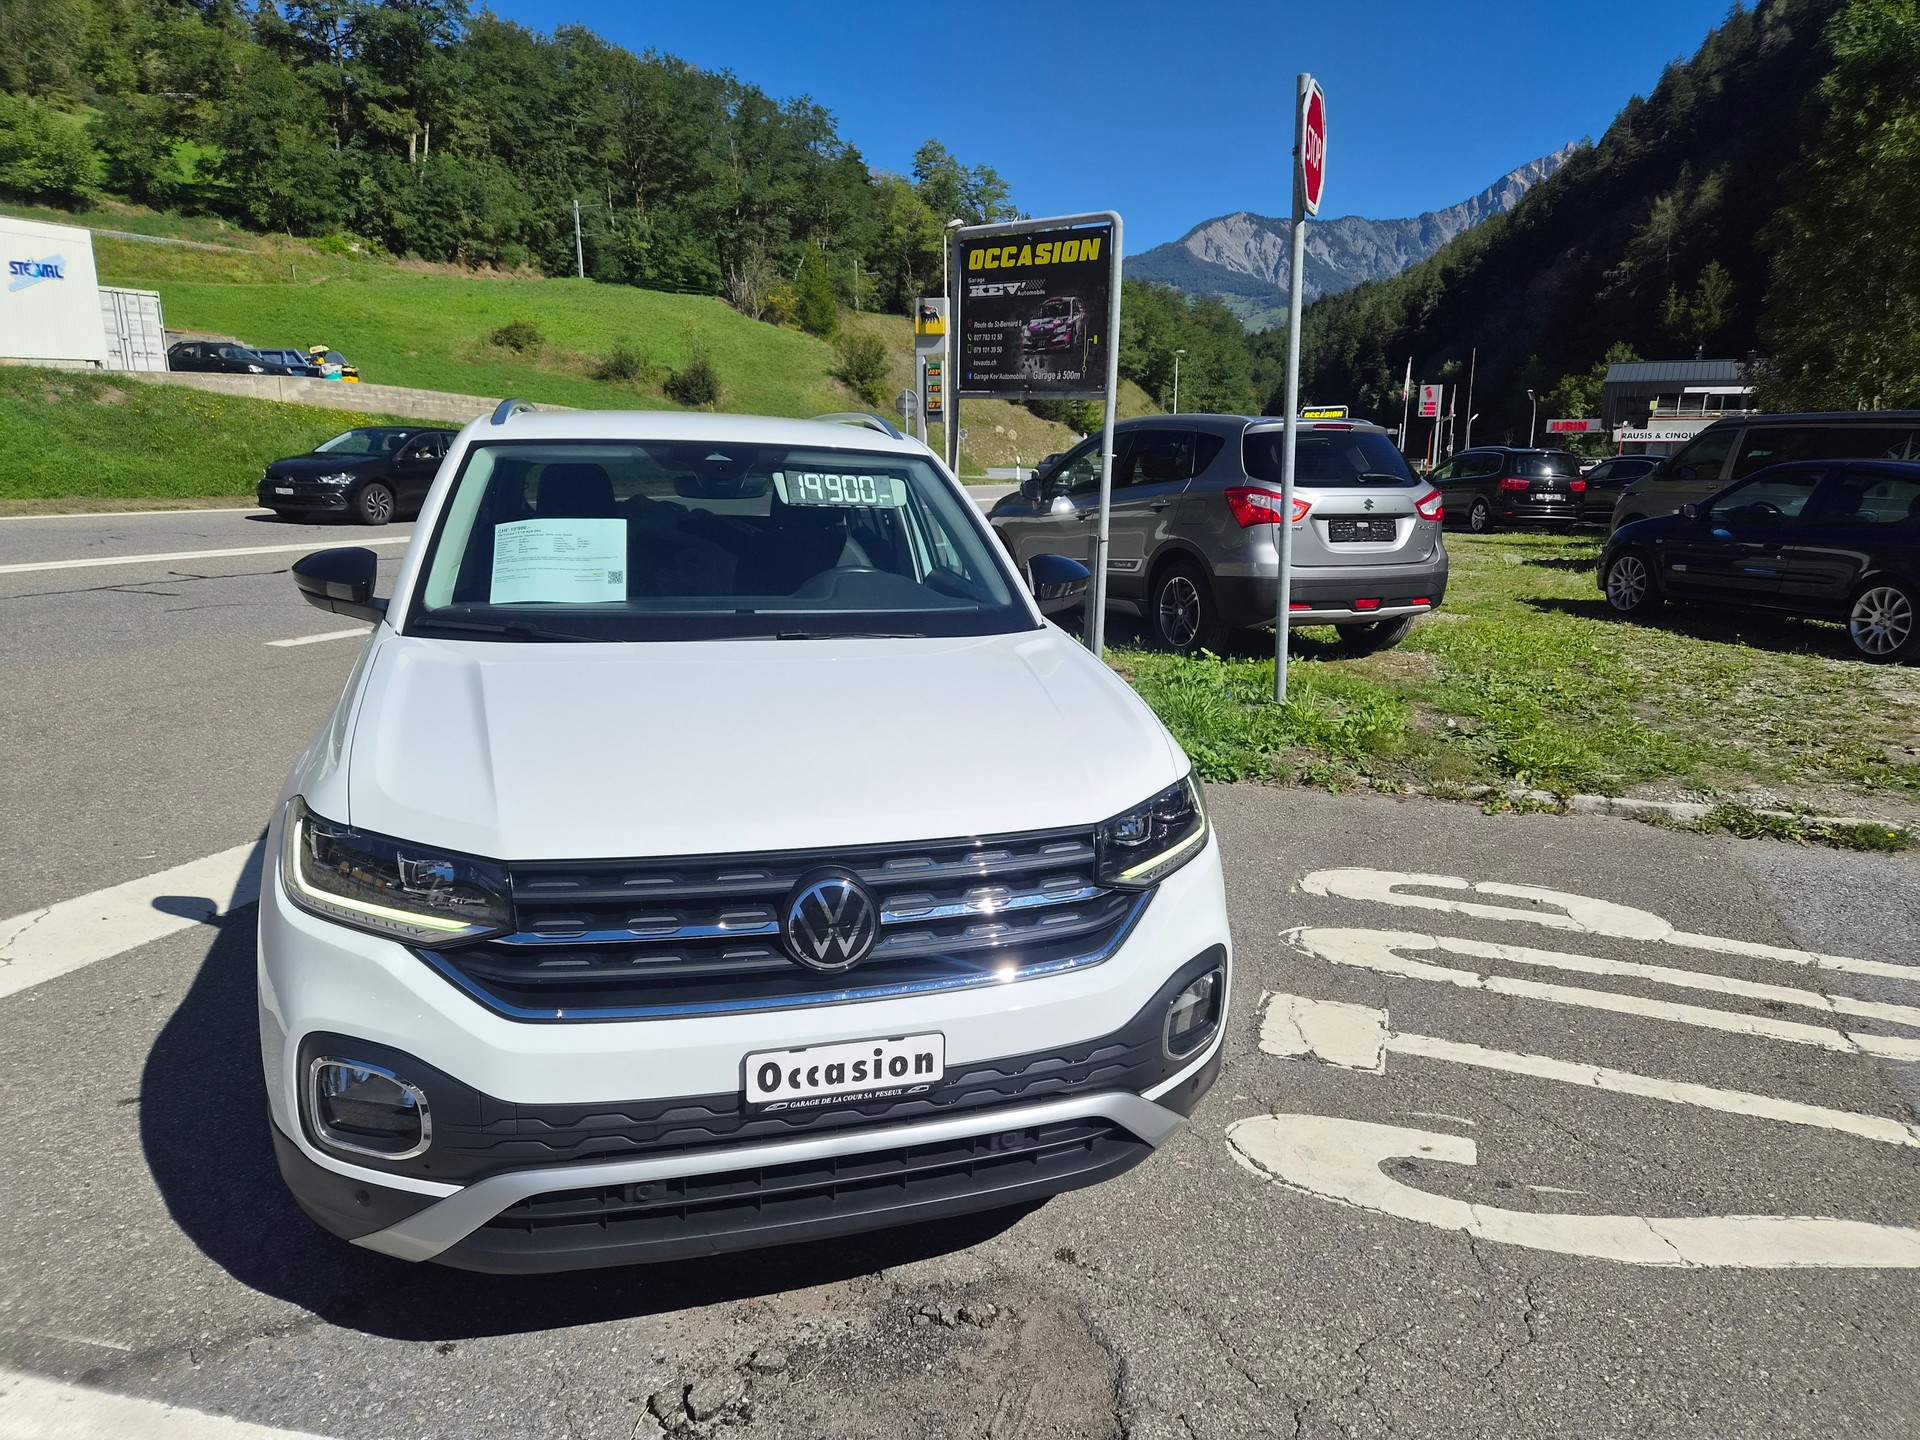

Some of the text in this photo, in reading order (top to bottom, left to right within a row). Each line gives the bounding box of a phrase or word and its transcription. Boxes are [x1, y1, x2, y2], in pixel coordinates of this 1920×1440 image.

[1306, 124, 1322, 171] STOP
[969, 238, 1101, 270] OCCASION
[994, 320, 1018, 328] St-Bernard
[973, 333, 982, 341] 027
[991, 333, 997, 341] 12
[973, 359, 997, 367] kevauto.ch
[973, 373, 989, 382] Garage
[1033, 369, 1081, 382] Garage à 500m
[1303, 410, 1344, 419] OCCASION
[1551, 420, 1588, 432] JUBIN
[1654, 431, 1661, 439] &
[756, 1047, 935, 1093] Occasion
[789, 1098, 821, 1109] GARAGE
[820, 1096, 832, 1105] DE
[842, 1094, 863, 1102] COUR
[874, 1088, 903, 1098] PESEUX
